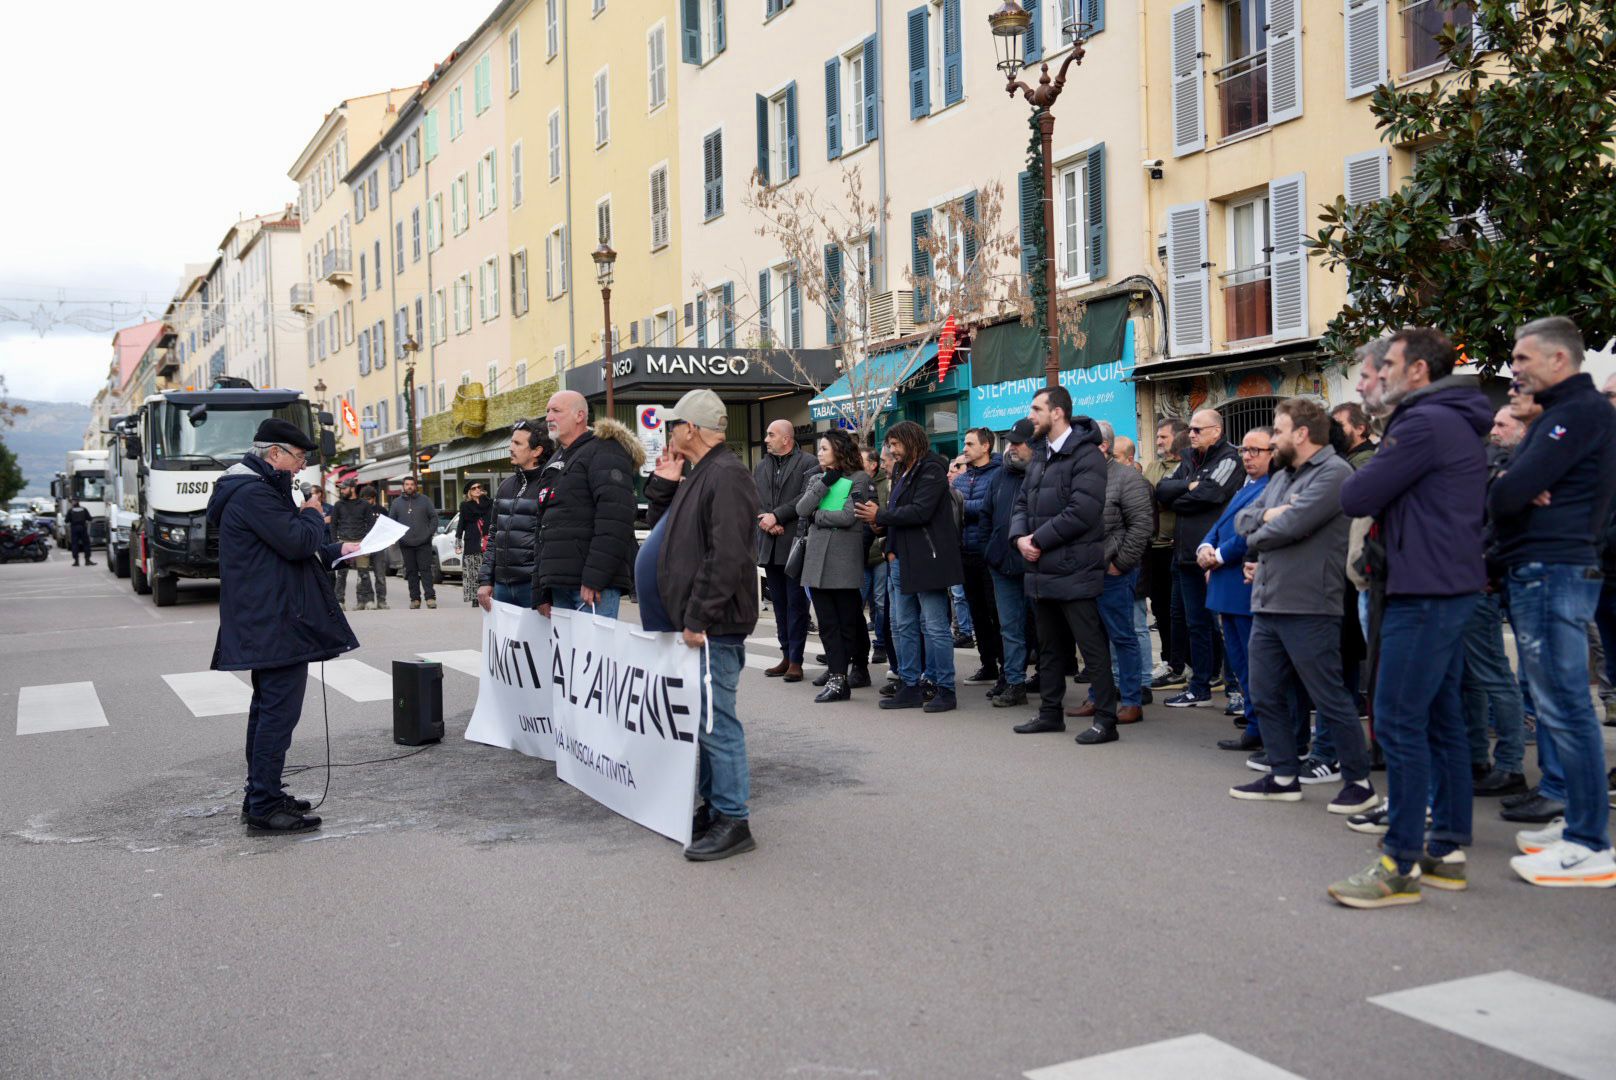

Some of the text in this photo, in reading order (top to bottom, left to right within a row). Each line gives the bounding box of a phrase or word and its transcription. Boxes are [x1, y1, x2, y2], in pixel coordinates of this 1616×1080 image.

[601, 358, 632, 381] MNGO
[646, 354, 749, 375] MANGO
[812, 405, 836, 417] TABAC
[176, 481, 209, 495] TASSO
[488, 628, 542, 689] UNITI
[518, 713, 553, 734] UNITI
